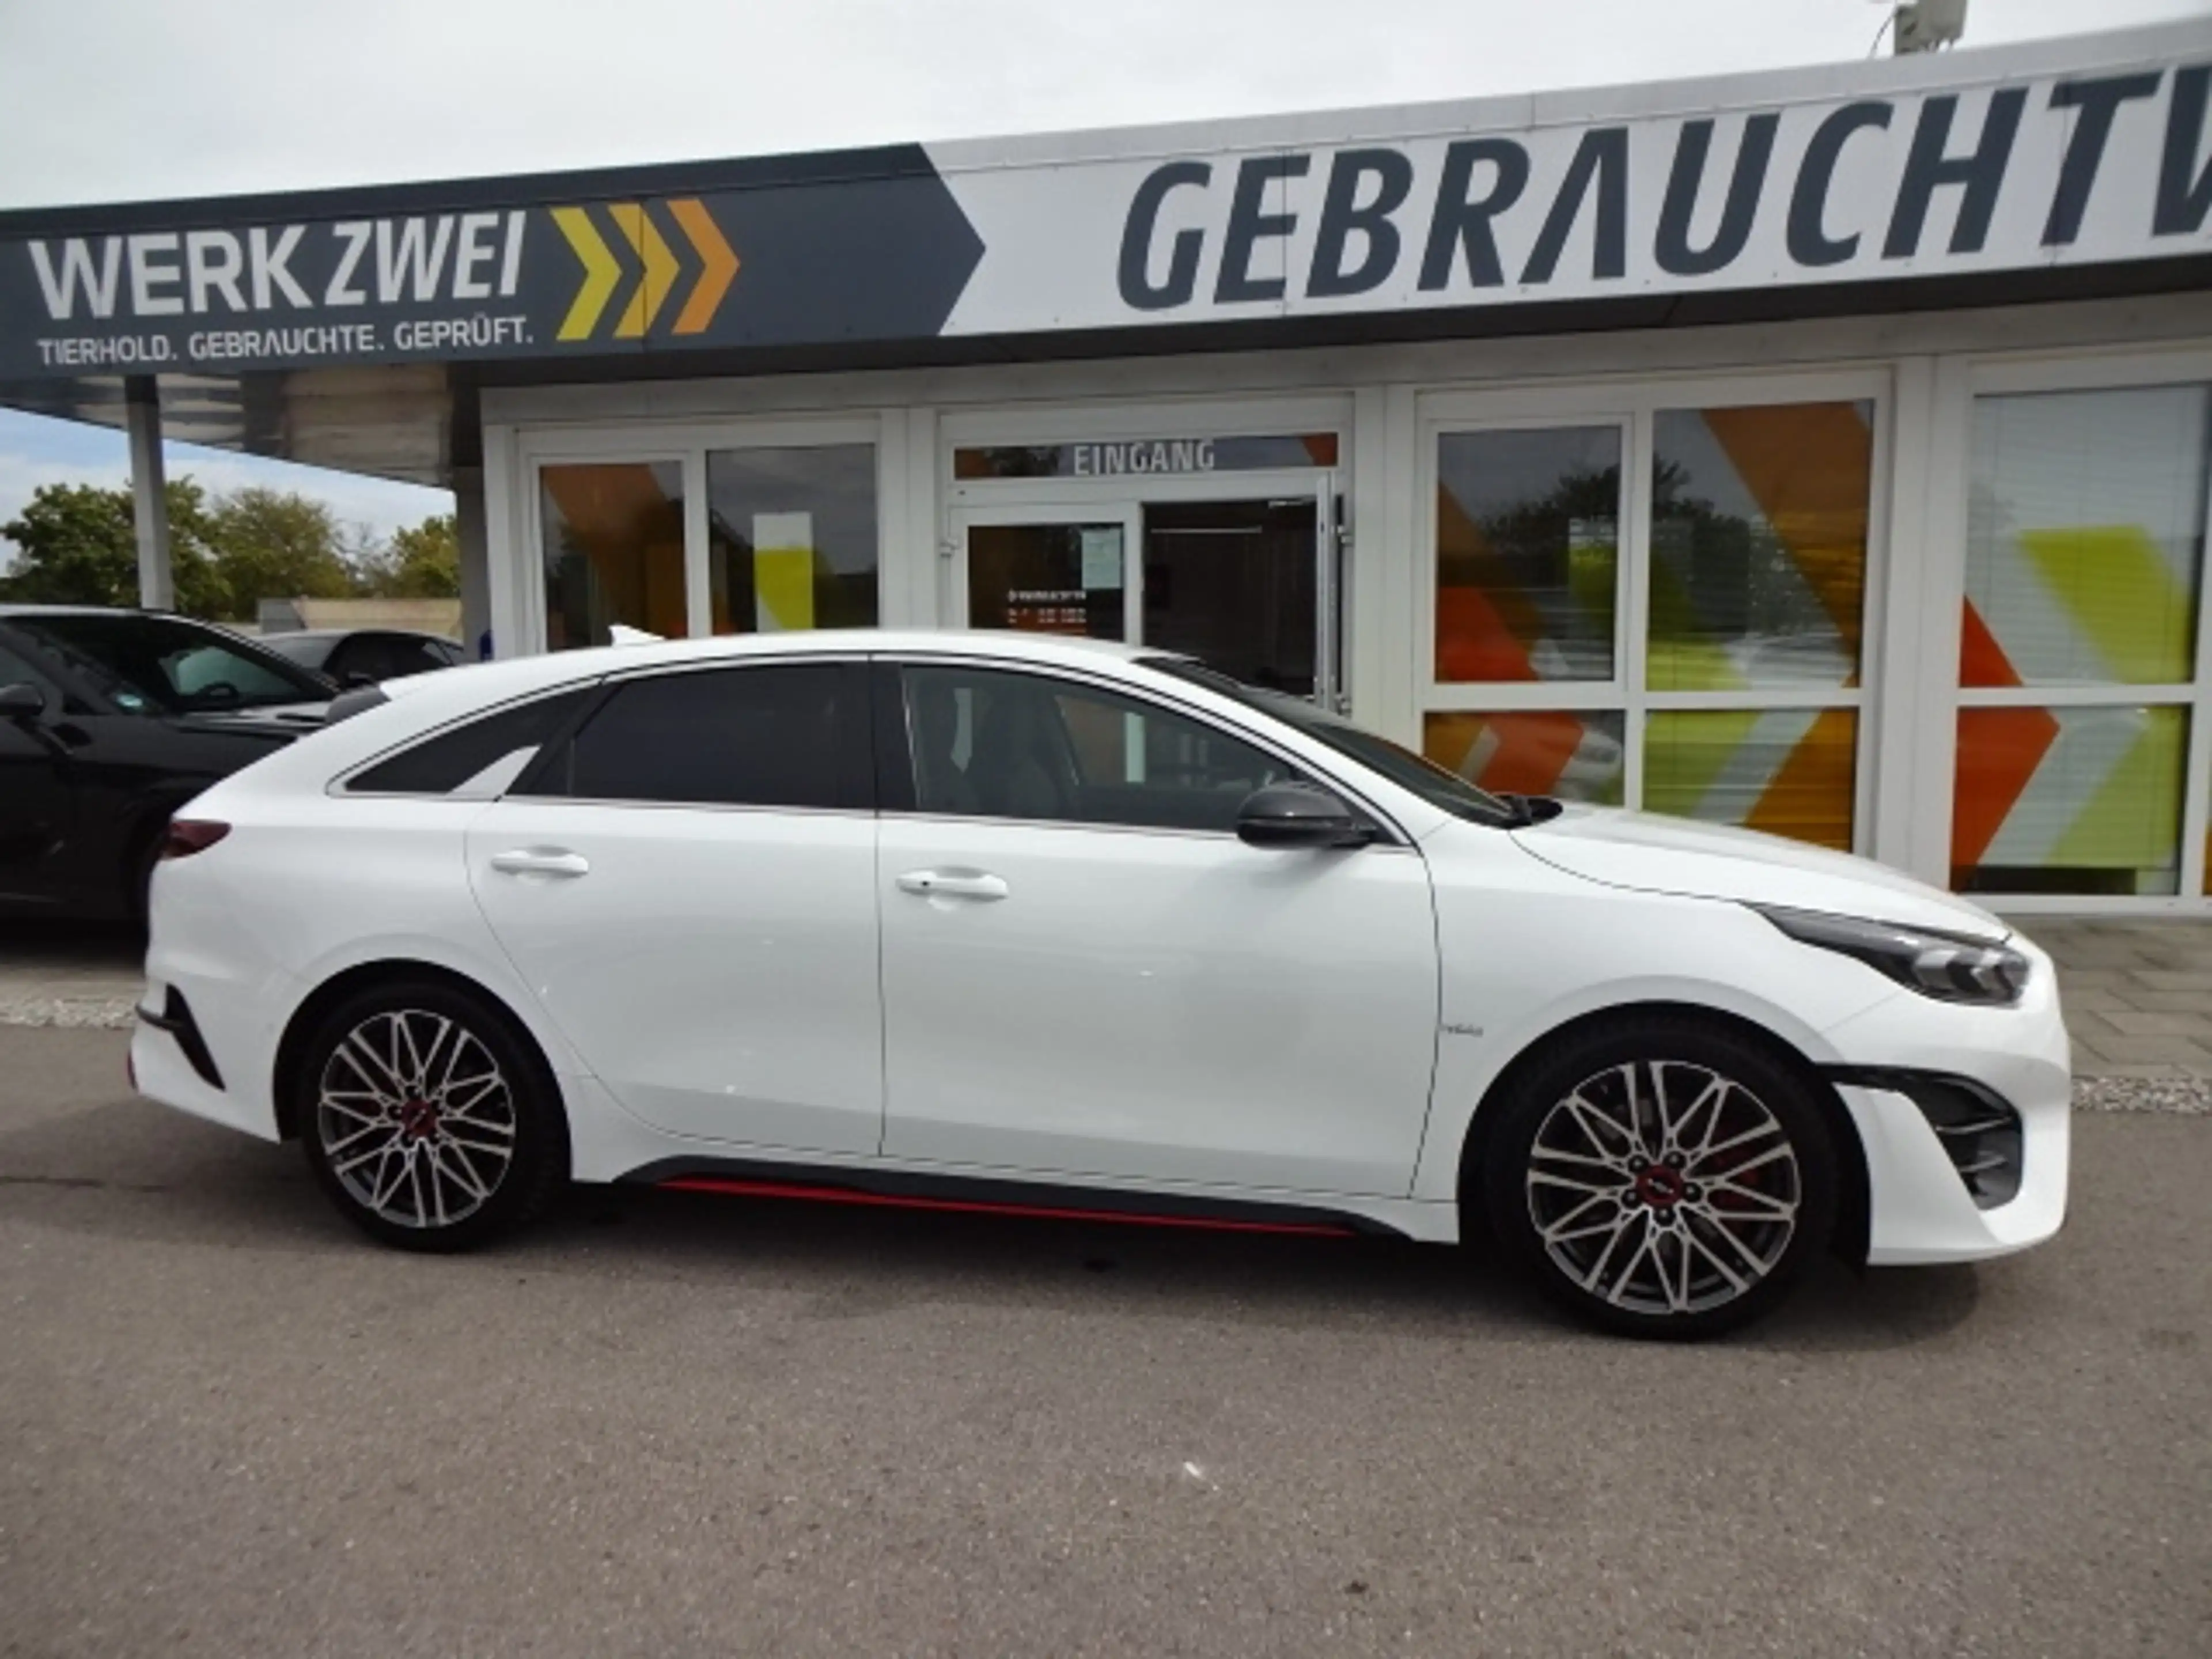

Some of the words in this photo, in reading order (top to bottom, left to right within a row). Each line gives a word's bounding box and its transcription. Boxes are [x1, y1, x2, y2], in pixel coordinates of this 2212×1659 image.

[28, 225, 313, 320] WERK
[324, 210, 527, 305] ZWEI
[38, 335, 177, 366] TIERHOLD.
[190, 324, 385, 361] GEBRAUCHTE.
[394, 313, 534, 351] GEPRÜFT.
[1073, 440, 1215, 475] EINGANG
